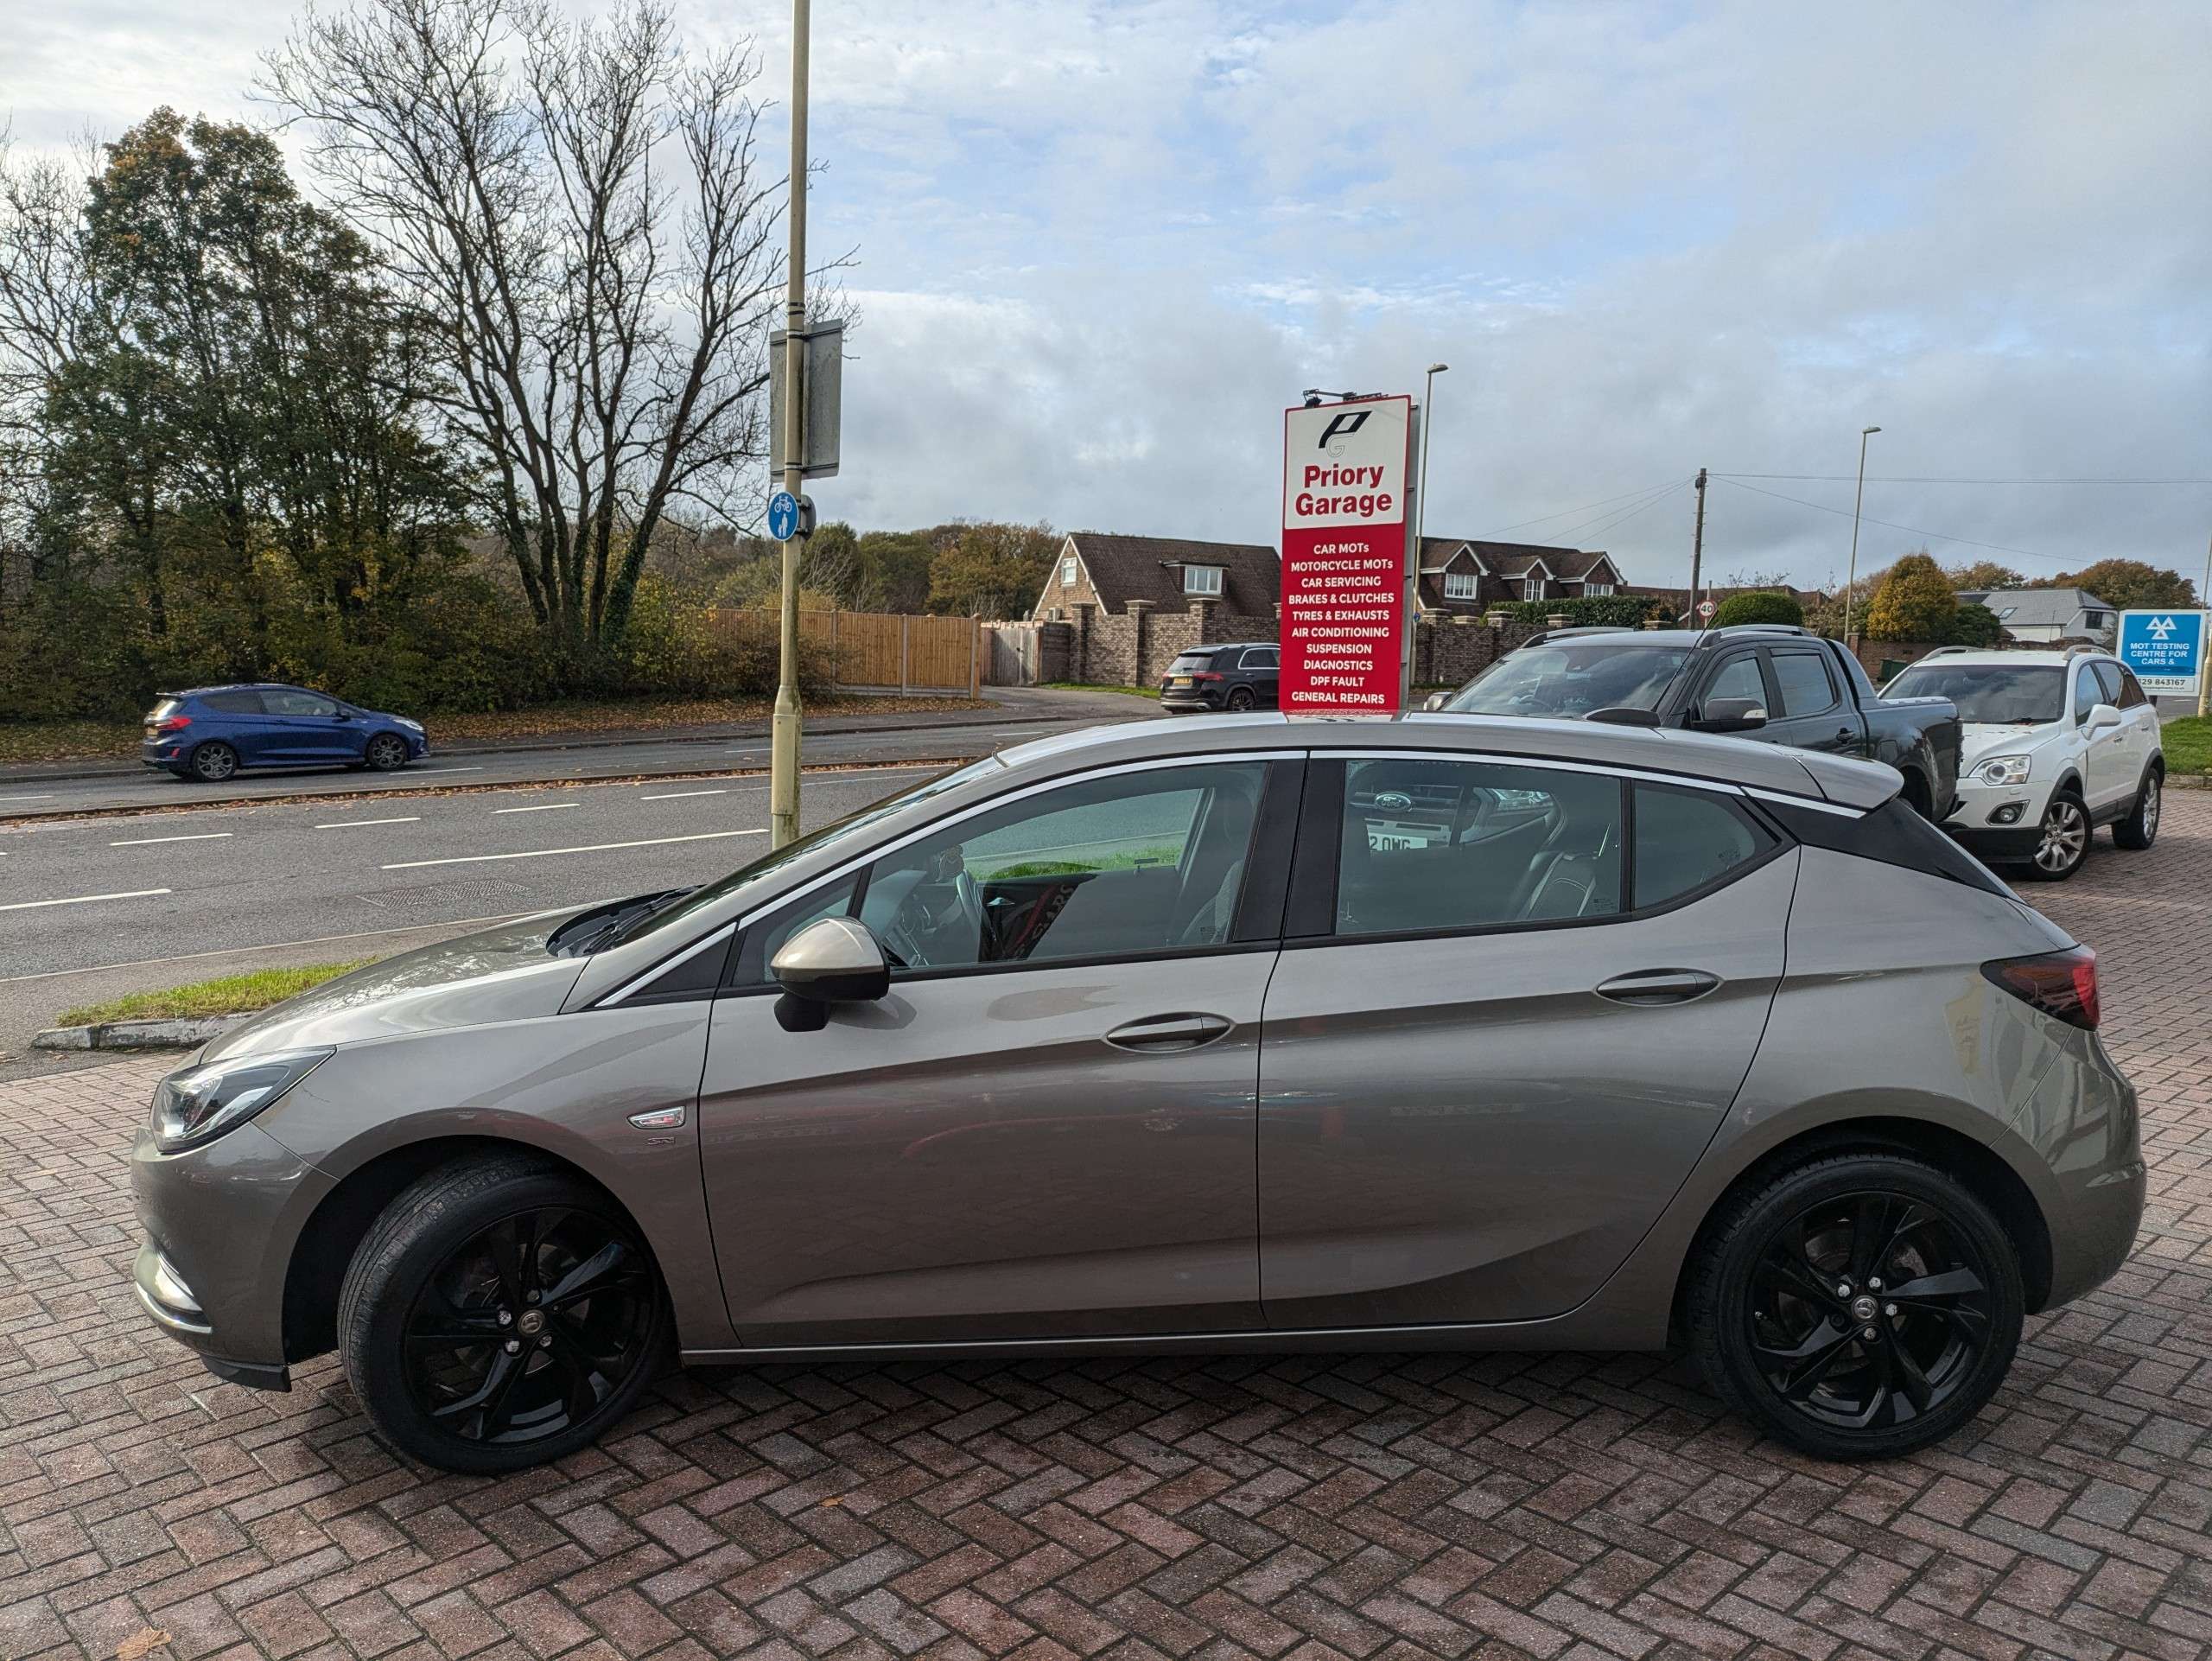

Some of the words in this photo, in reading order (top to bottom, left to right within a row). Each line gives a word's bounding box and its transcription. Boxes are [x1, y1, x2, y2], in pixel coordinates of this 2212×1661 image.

[1304, 464, 1384, 488] Priory
[1295, 493, 1393, 518] Garage
[1314, 544, 1335, 554] CAR
[1339, 543, 1369, 553] MOTs
[1292, 560, 1360, 571] MOTORCYCLE
[1363, 559, 1392, 569] MOTs
[1302, 578, 1322, 588] CAR
[1325, 576, 1381, 587] SERVICING
[1289, 595, 1327, 604] BRAKES
[1330, 595, 1337, 603] &
[1339, 593, 1394, 603] CLUTCHES
[1293, 611, 1322, 620] TYRES
[1325, 611, 1332, 620] &
[1335, 610, 1389, 620] EXHAUSTS
[1292, 628, 1308, 637] AIR
[1312, 627, 1389, 637] CONDITIONING
[1306, 644, 1371, 653] SUSPENSION
[1304, 660, 1372, 670] DIAGNOSTICS
[1311, 677, 1330, 685] DPF
[1332, 677, 1364, 686] FAULT
[1292, 692, 1338, 702] GENERAL
[1340, 693, 1384, 703] REPAIRS
